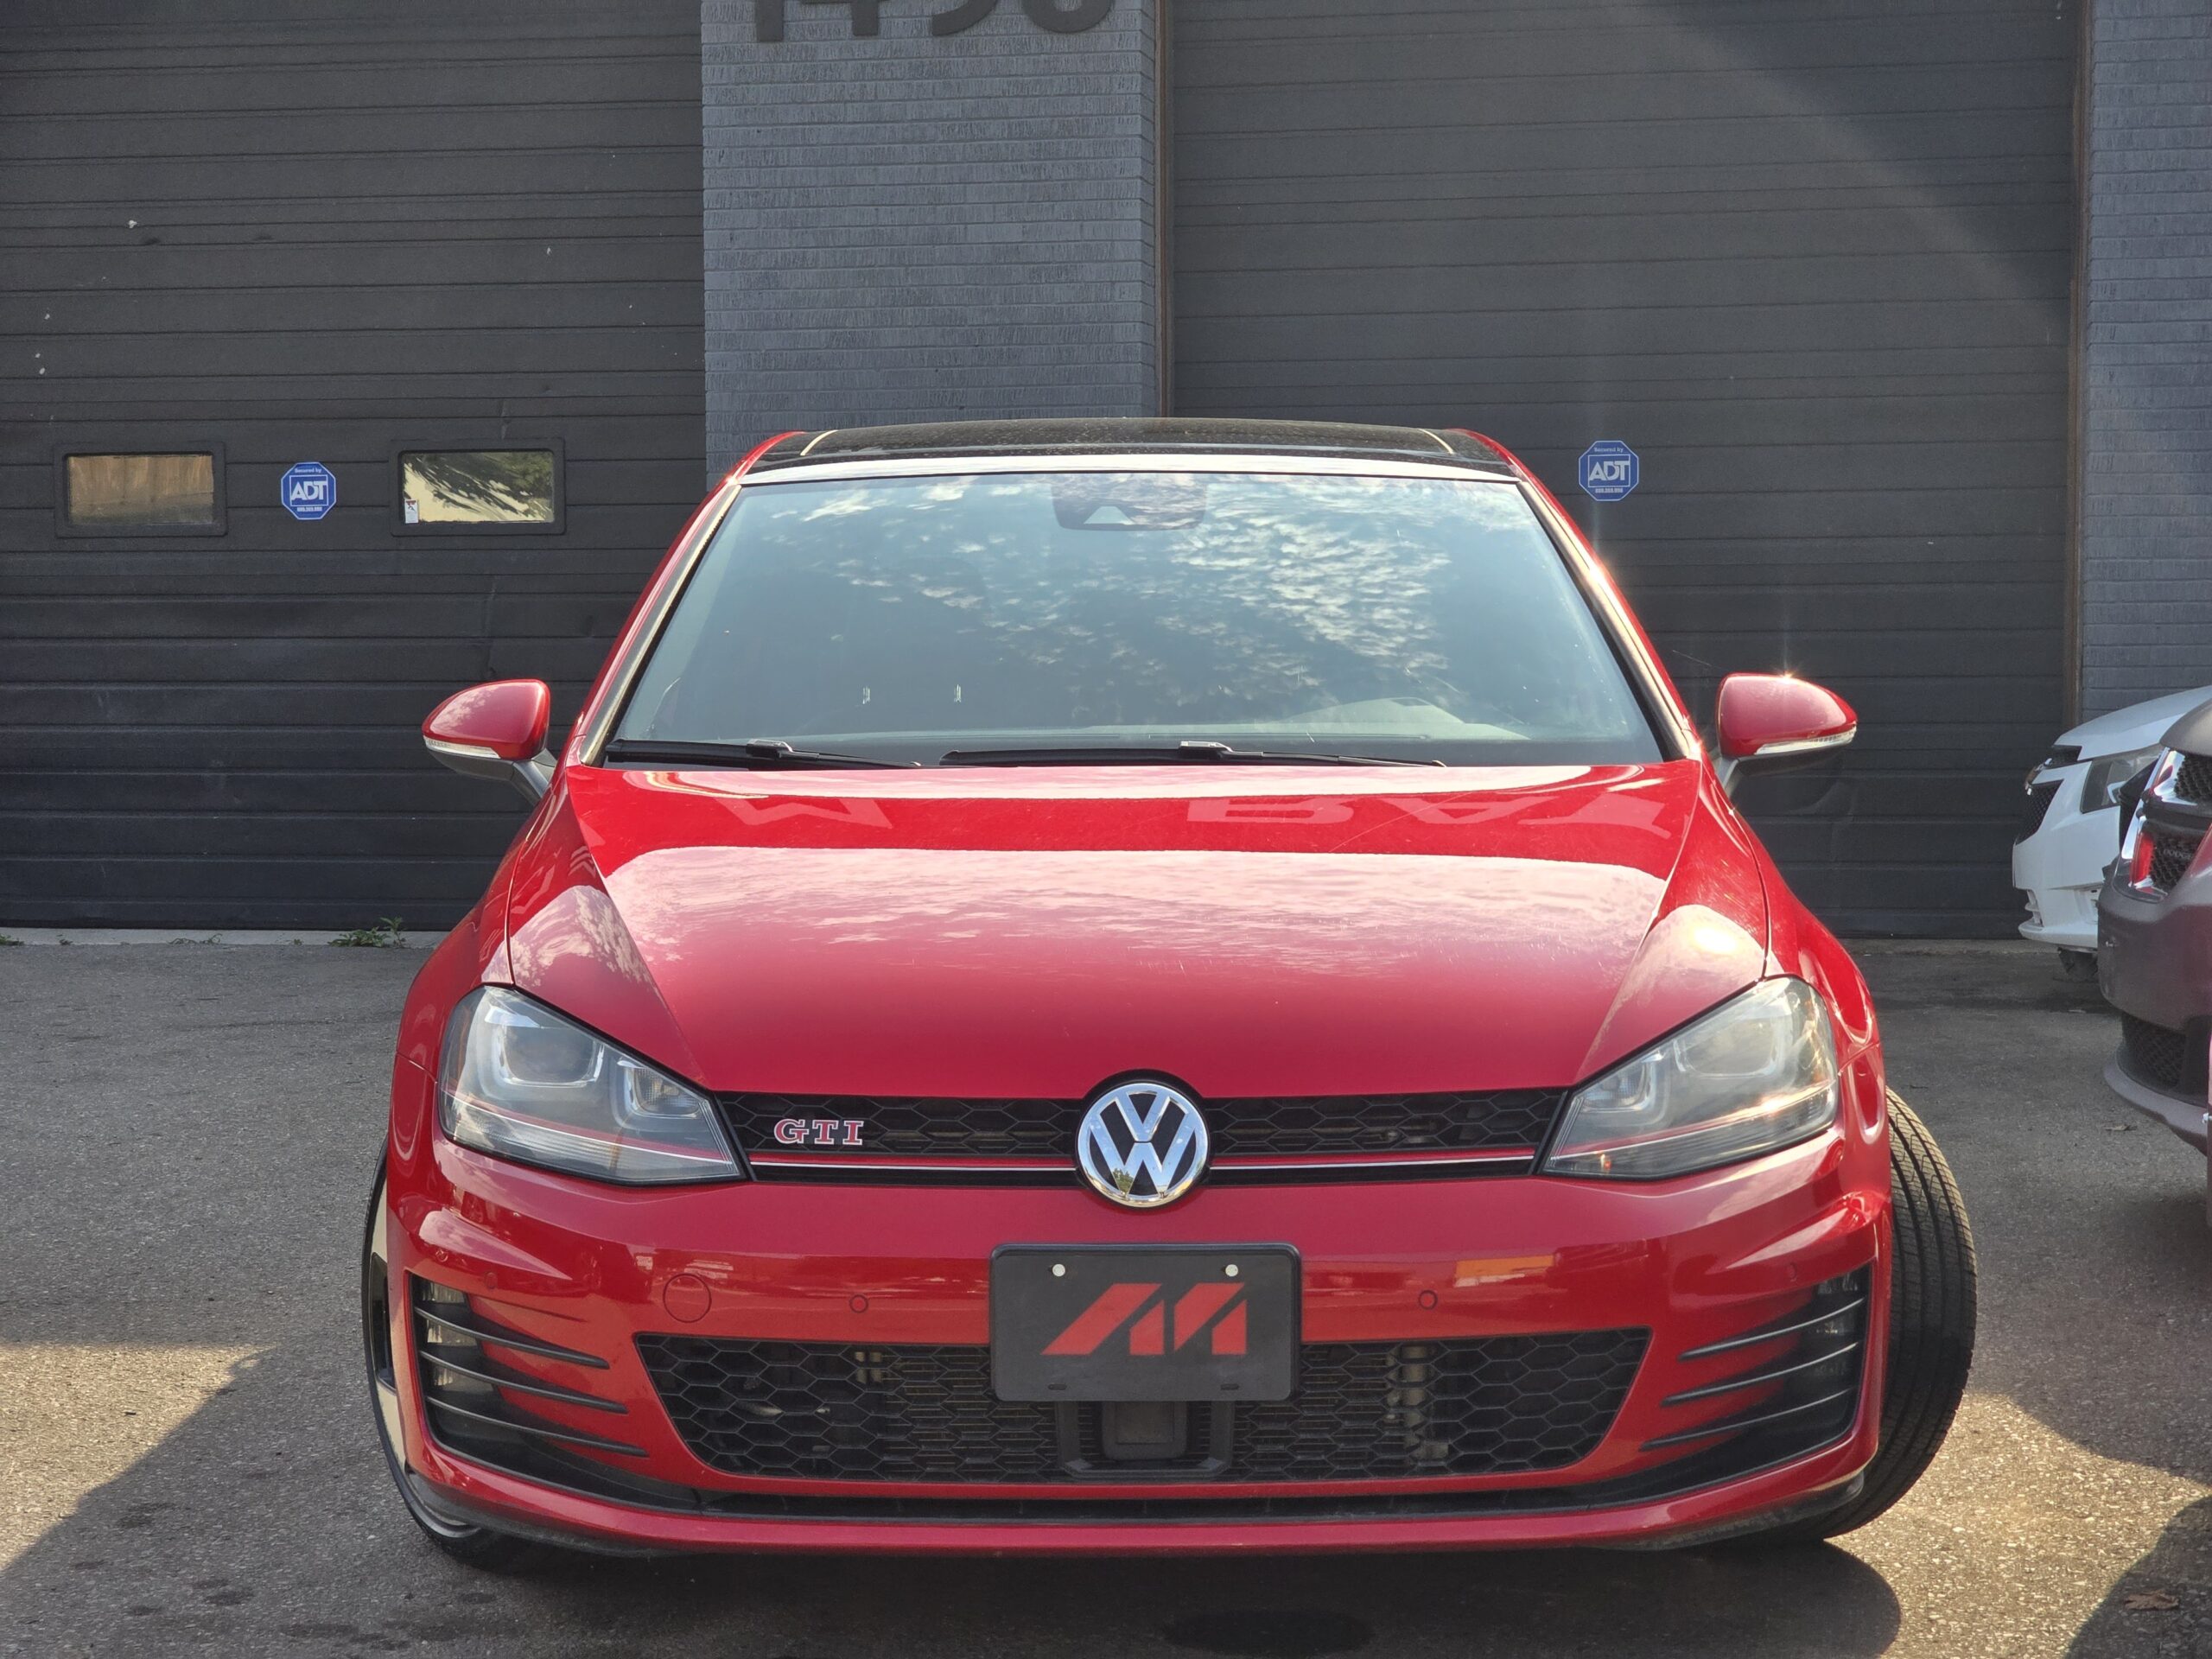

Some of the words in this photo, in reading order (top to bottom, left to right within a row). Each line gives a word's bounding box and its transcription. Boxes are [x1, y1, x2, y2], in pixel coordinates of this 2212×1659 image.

[1589, 461, 1630, 480] ADT
[291, 480, 327, 500] ADT
[774, 1118, 864, 1146] GTI
